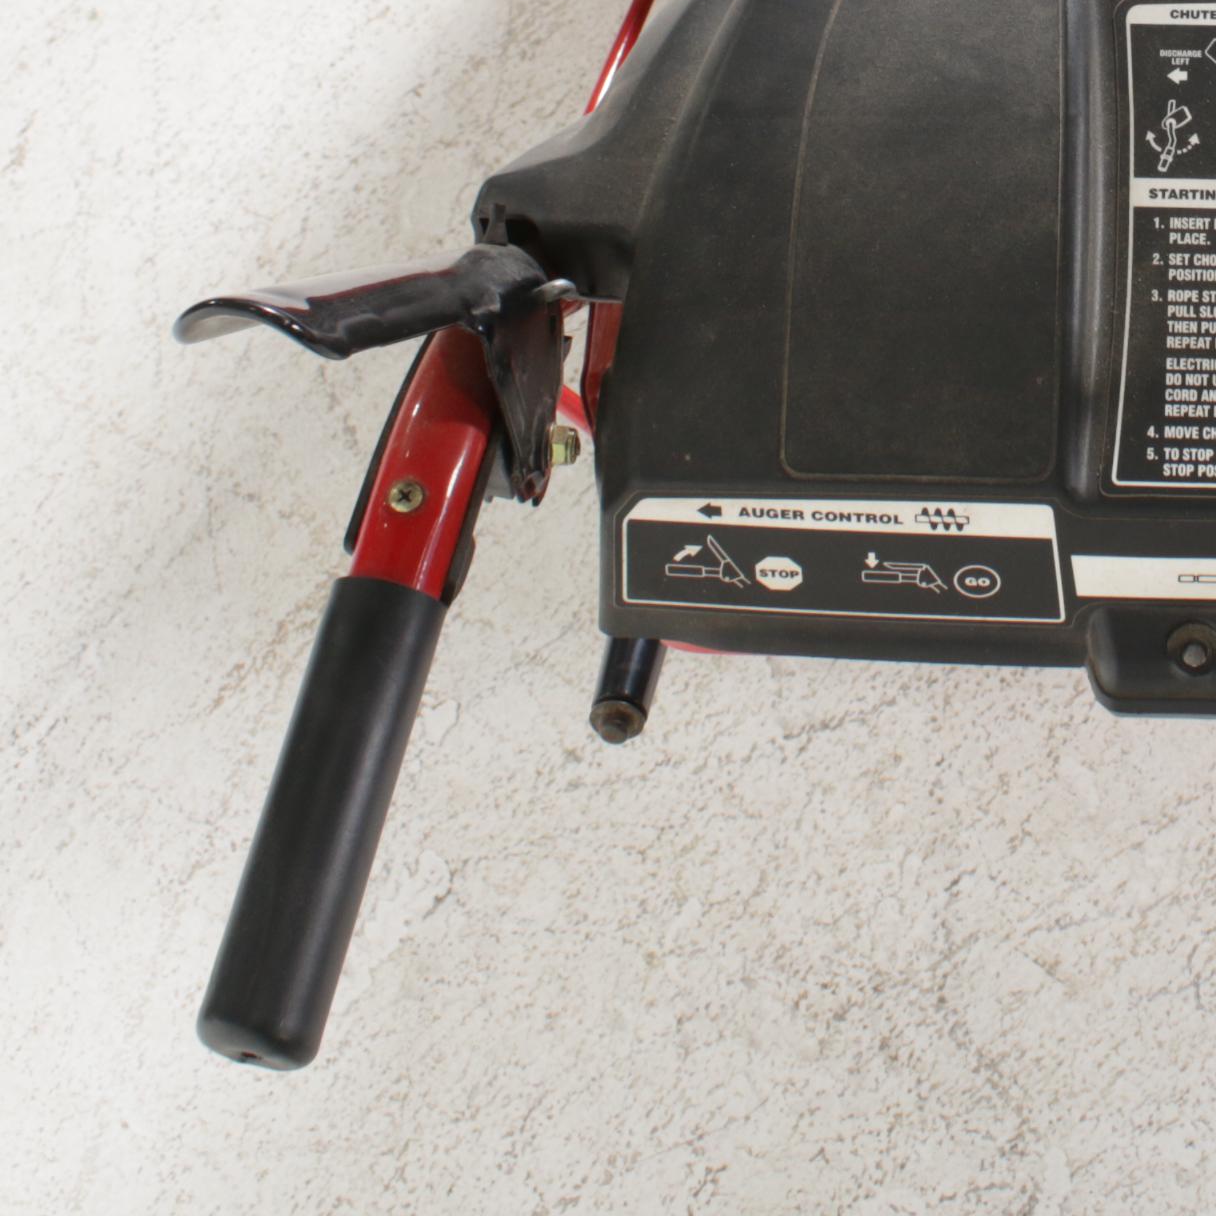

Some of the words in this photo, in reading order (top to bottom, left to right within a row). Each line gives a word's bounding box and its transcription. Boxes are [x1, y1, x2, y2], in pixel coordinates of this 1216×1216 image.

[1160, 50, 1202, 58] DISCHARGE
[1154, 218, 1164, 229] 1.
[1170, 218, 1210, 230] INSERT
[1169, 234, 1211, 245] PLACE.
[1152, 254, 1164, 265] 2.
[1168, 254, 1190, 266] SET
[1152, 290, 1163, 302] 3.
[1168, 290, 1199, 302] ROPE
[1168, 306, 1196, 318] PULL
[1168, 321, 1198, 333] THEN
[1167, 337, 1211, 349] REPEAT
[1166, 374, 1181, 386] DO
[1185, 375, 1209, 386] NOT
[1166, 389, 1198, 401] CORD
[1165, 405, 1210, 417] REPEAT
[1147, 426, 1159, 438] 4.
[1164, 426, 1199, 439] MOVE
[1147, 448, 1158, 460] 5.
[1164, 449, 1180, 460] TO
[1183, 449, 1214, 461] STOP
[1163, 465, 1194, 477] STOP
[739, 507, 805, 520] AUGER
[811, 509, 903, 524] CONTROL
[759, 568, 799, 579] STOP
[964, 576, 990, 587] GO
